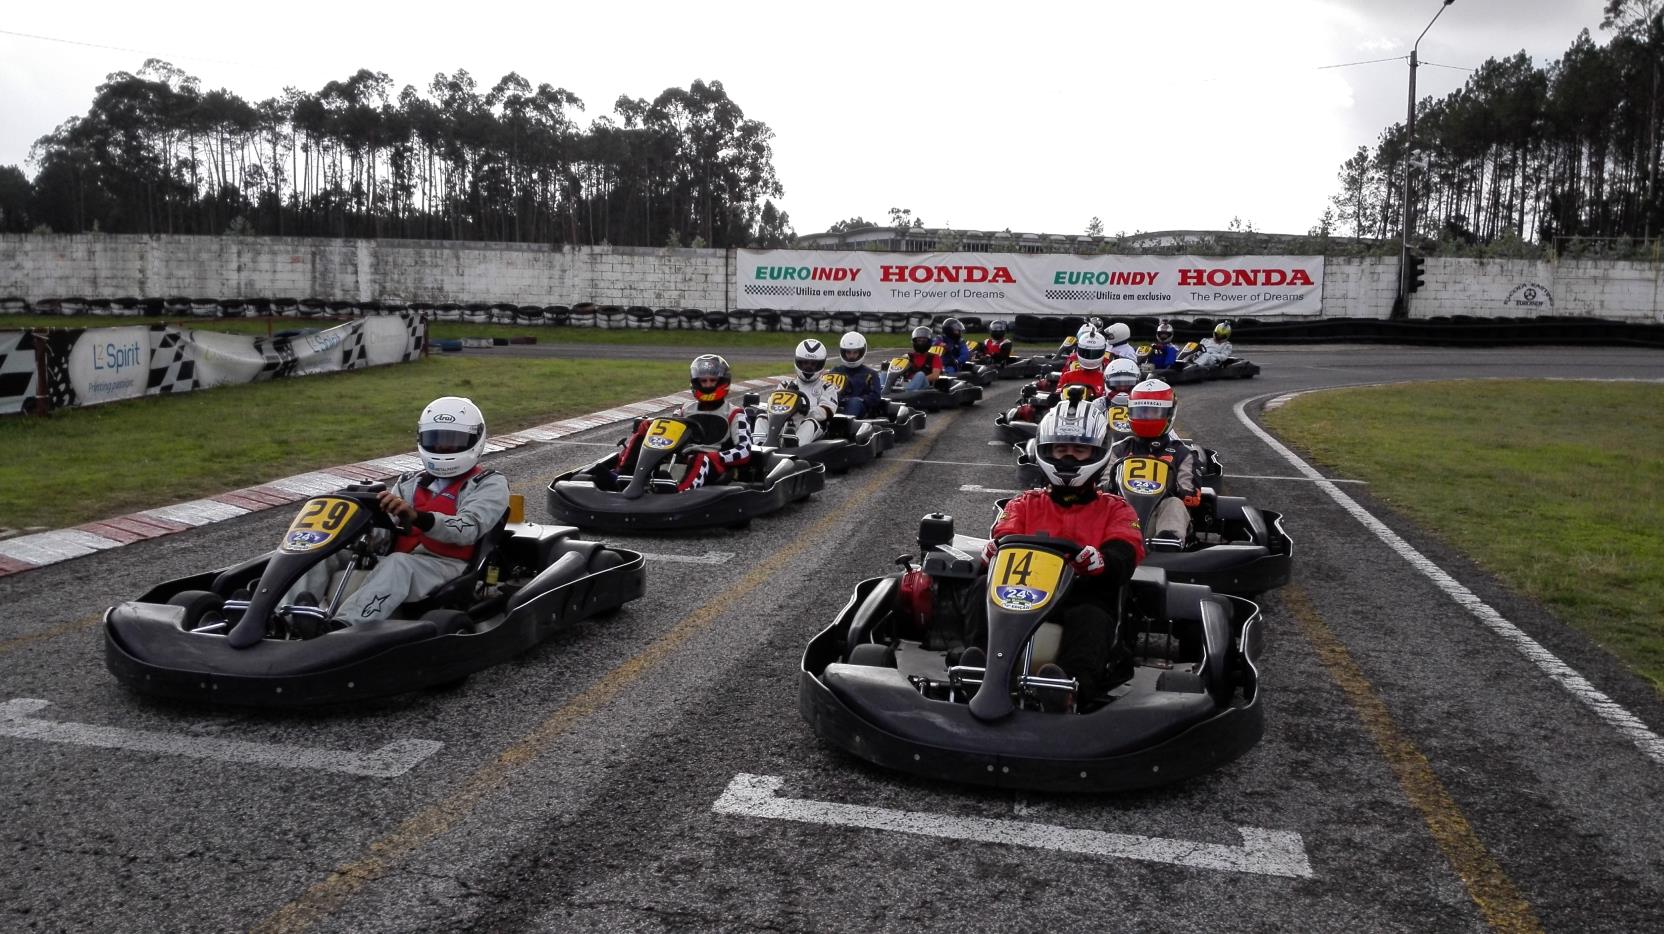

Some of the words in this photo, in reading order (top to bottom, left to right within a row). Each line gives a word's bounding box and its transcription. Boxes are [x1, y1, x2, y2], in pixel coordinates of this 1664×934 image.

[754, 266, 862, 281] EUROINDY
[879, 265, 1017, 283] HONDA
[1053, 271, 1160, 285] EUROINDY
[1177, 269, 1315, 286] HONDA
[796, 286, 821, 296] Utiliza
[837, 288, 872, 298] exclusivo
[890, 289, 911, 298] The
[914, 289, 947, 298] Power
[950, 289, 961, 298] of
[963, 289, 1005, 299] Dreams
[1096, 291, 1121, 300] Utiliza
[1137, 292, 1172, 301] exclusivo
[1190, 292, 1211, 301] The
[1213, 293, 1247, 301] Power
[1250, 293, 1261, 301] of
[1263, 293, 1304, 301] Dreams
[106, 341, 140, 374] Spirit
[773, 392, 795, 405] 27
[652, 420, 670, 435] 5
[1129, 459, 1158, 481] 21
[295, 500, 350, 530] 29
[1002, 551, 1034, 587] 14
